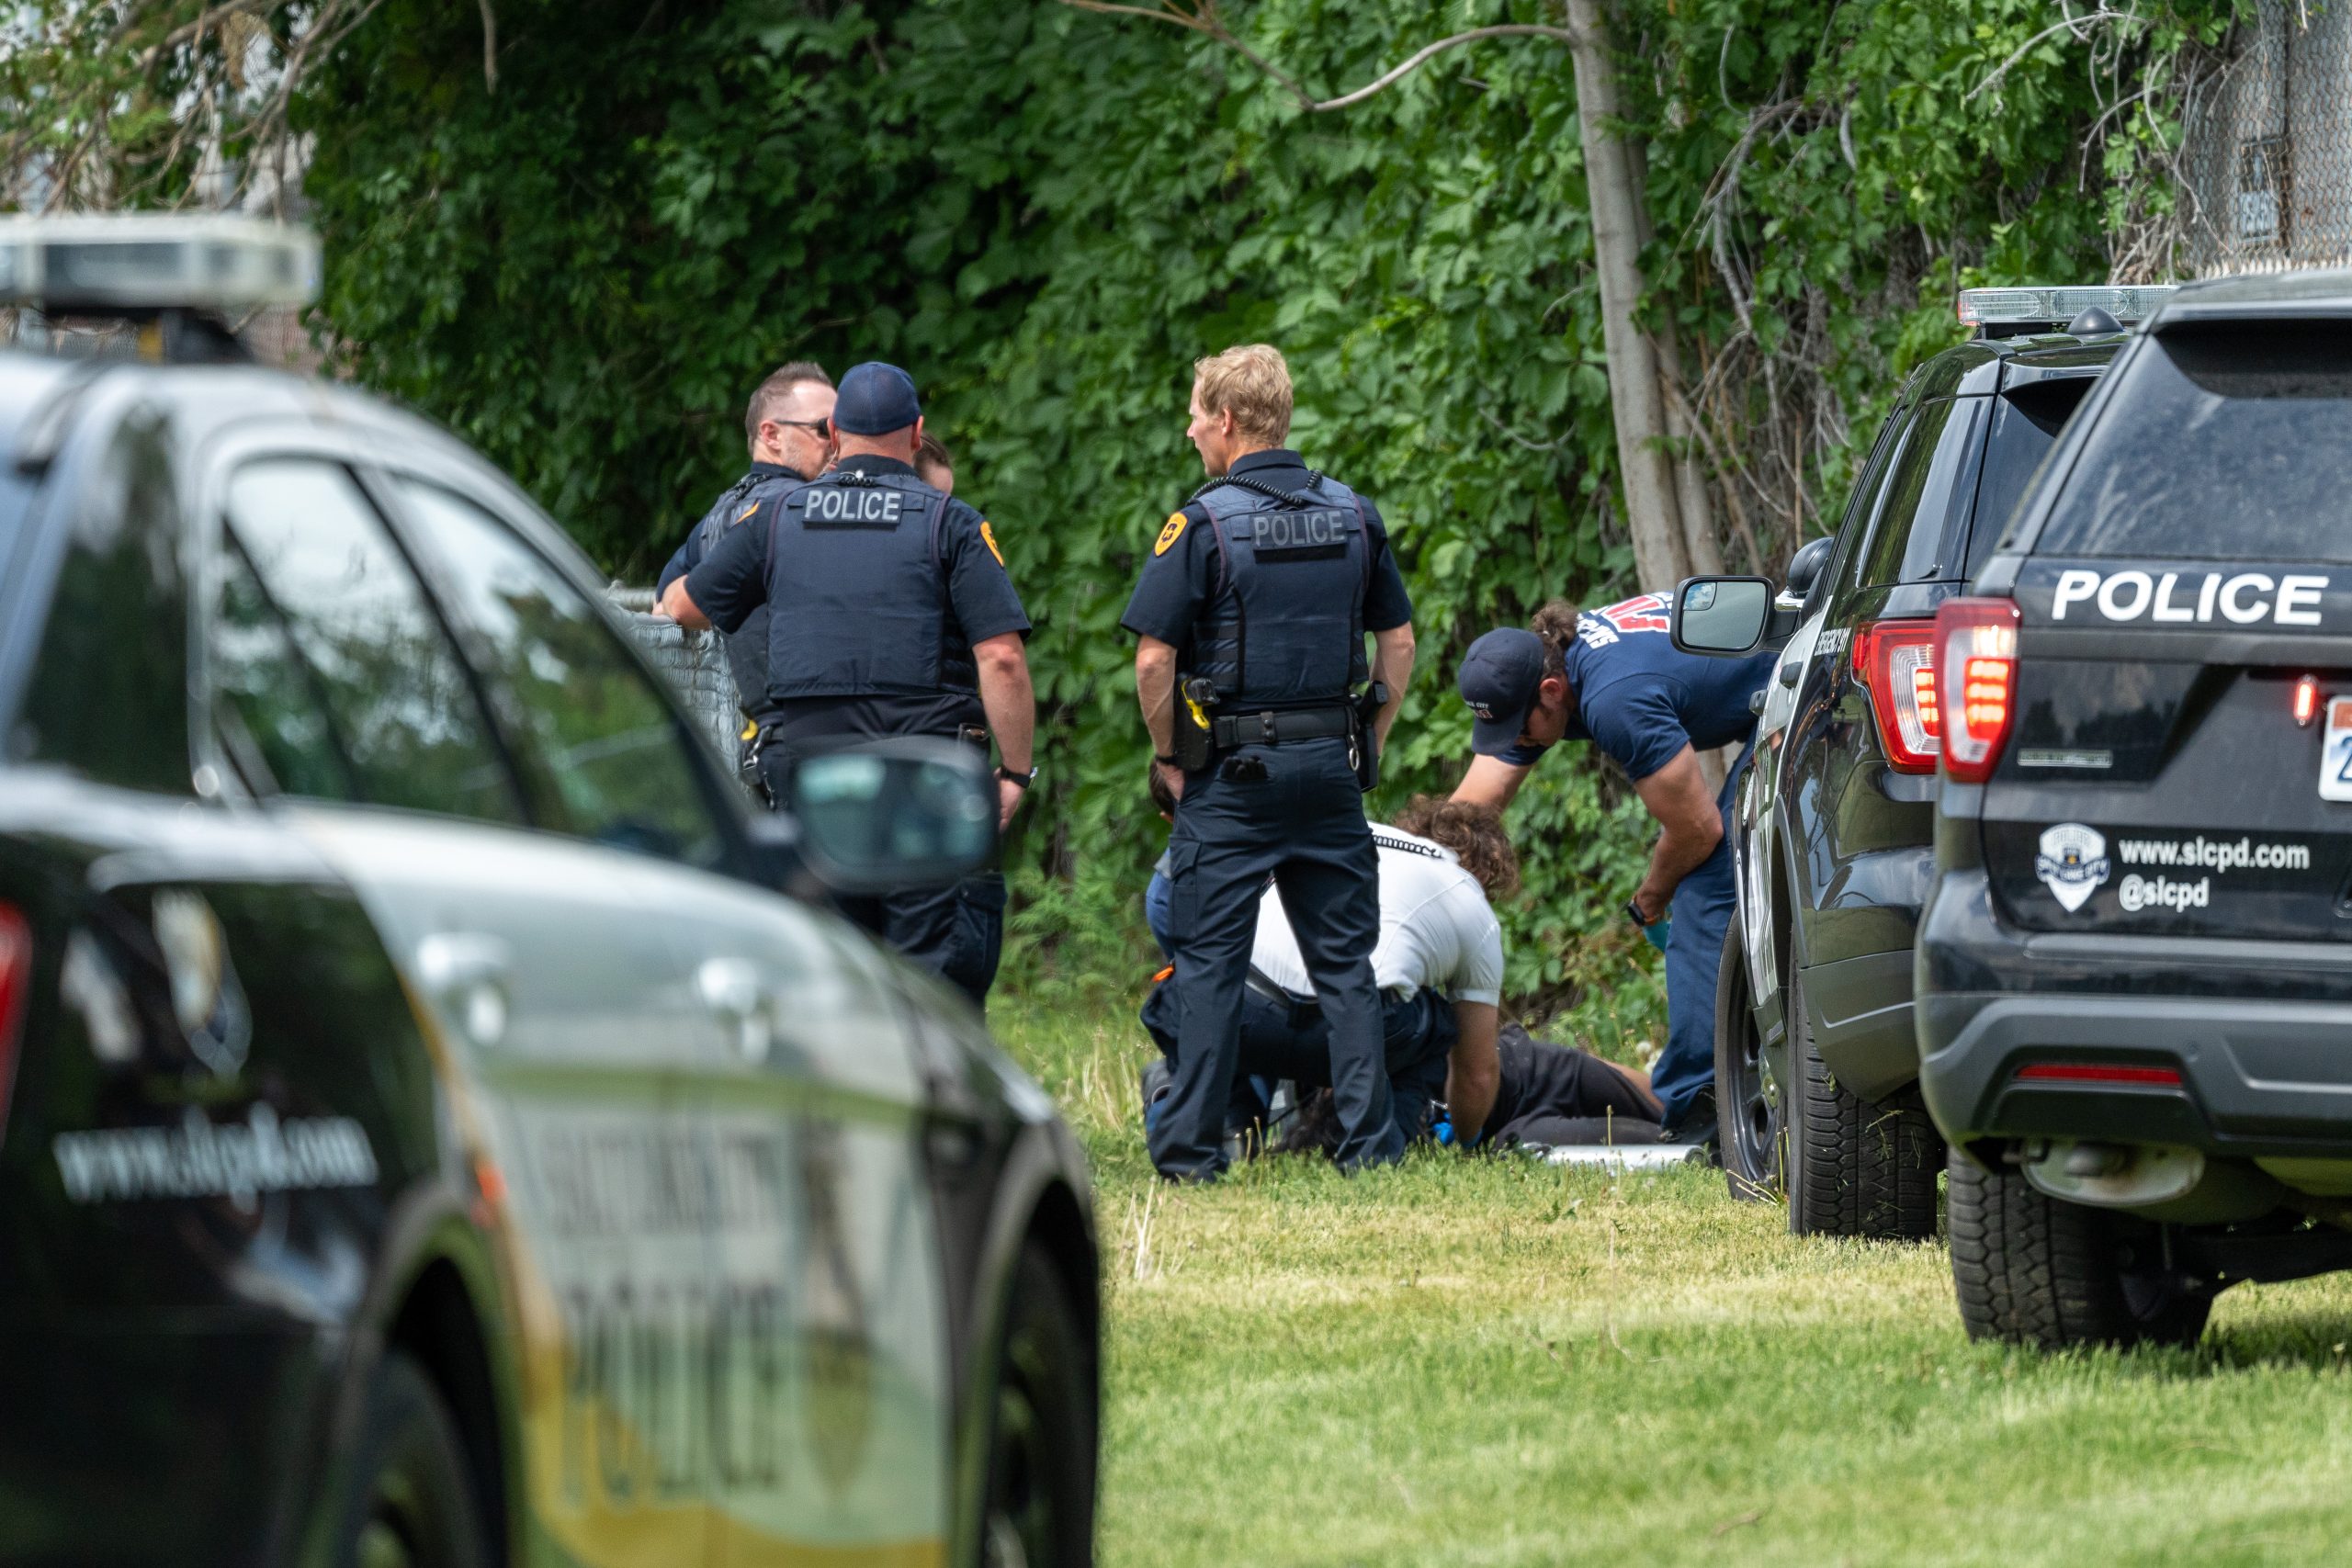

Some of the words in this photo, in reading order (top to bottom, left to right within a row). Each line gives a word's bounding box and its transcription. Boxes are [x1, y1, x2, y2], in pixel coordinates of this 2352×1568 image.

[805, 490, 901, 522] POLICE
[1253, 511, 1346, 547] POLICE
[2052, 570, 2330, 626] POLICE
[2119, 835, 2311, 874] www.slcpd.com
[2119, 874, 2210, 913] @slcpd
